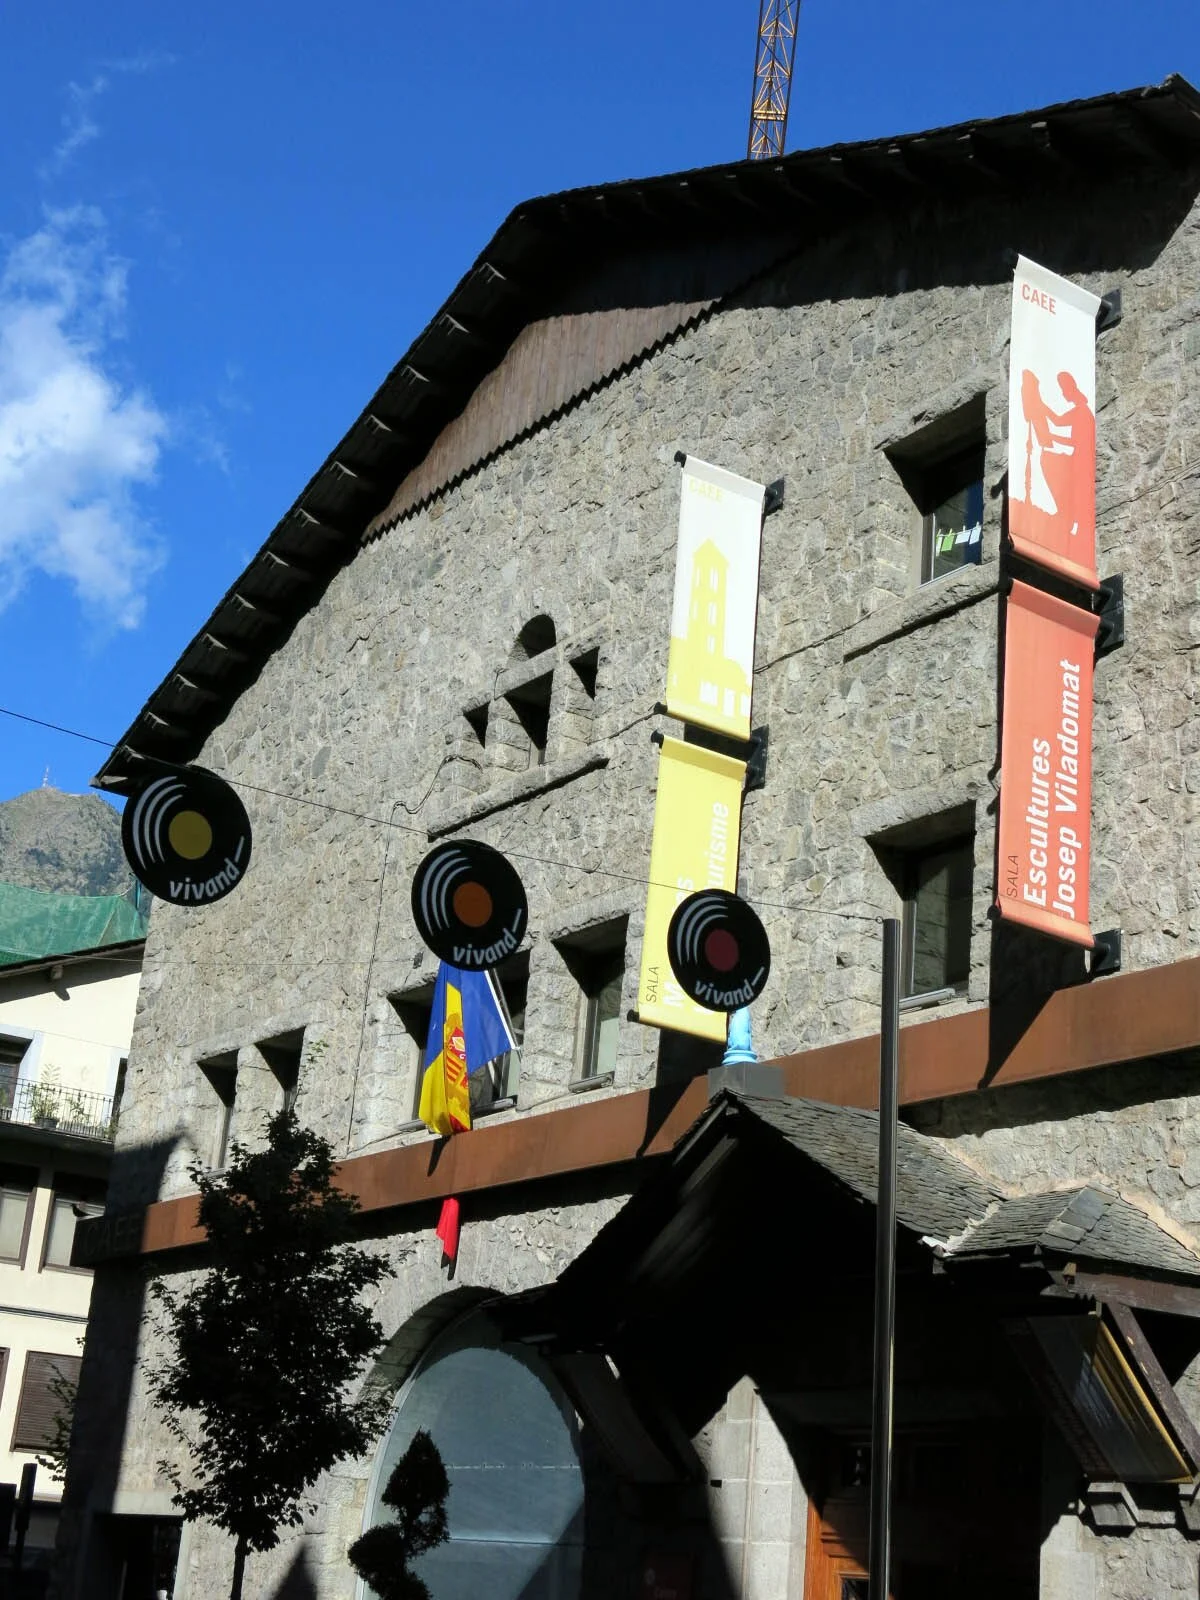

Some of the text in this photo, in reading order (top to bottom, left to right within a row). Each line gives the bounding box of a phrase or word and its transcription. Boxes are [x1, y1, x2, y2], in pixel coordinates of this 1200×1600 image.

[1021, 283, 1056, 316] CAEE
[689, 478, 722, 503] CAEE
[1053, 658, 1083, 920] Josep Viladomat
[1023, 737, 1052, 908] Escultures
[703, 801, 730, 890] urisme
[1006, 854, 1019, 898] SALA
[645, 965, 660, 1003] SALA
